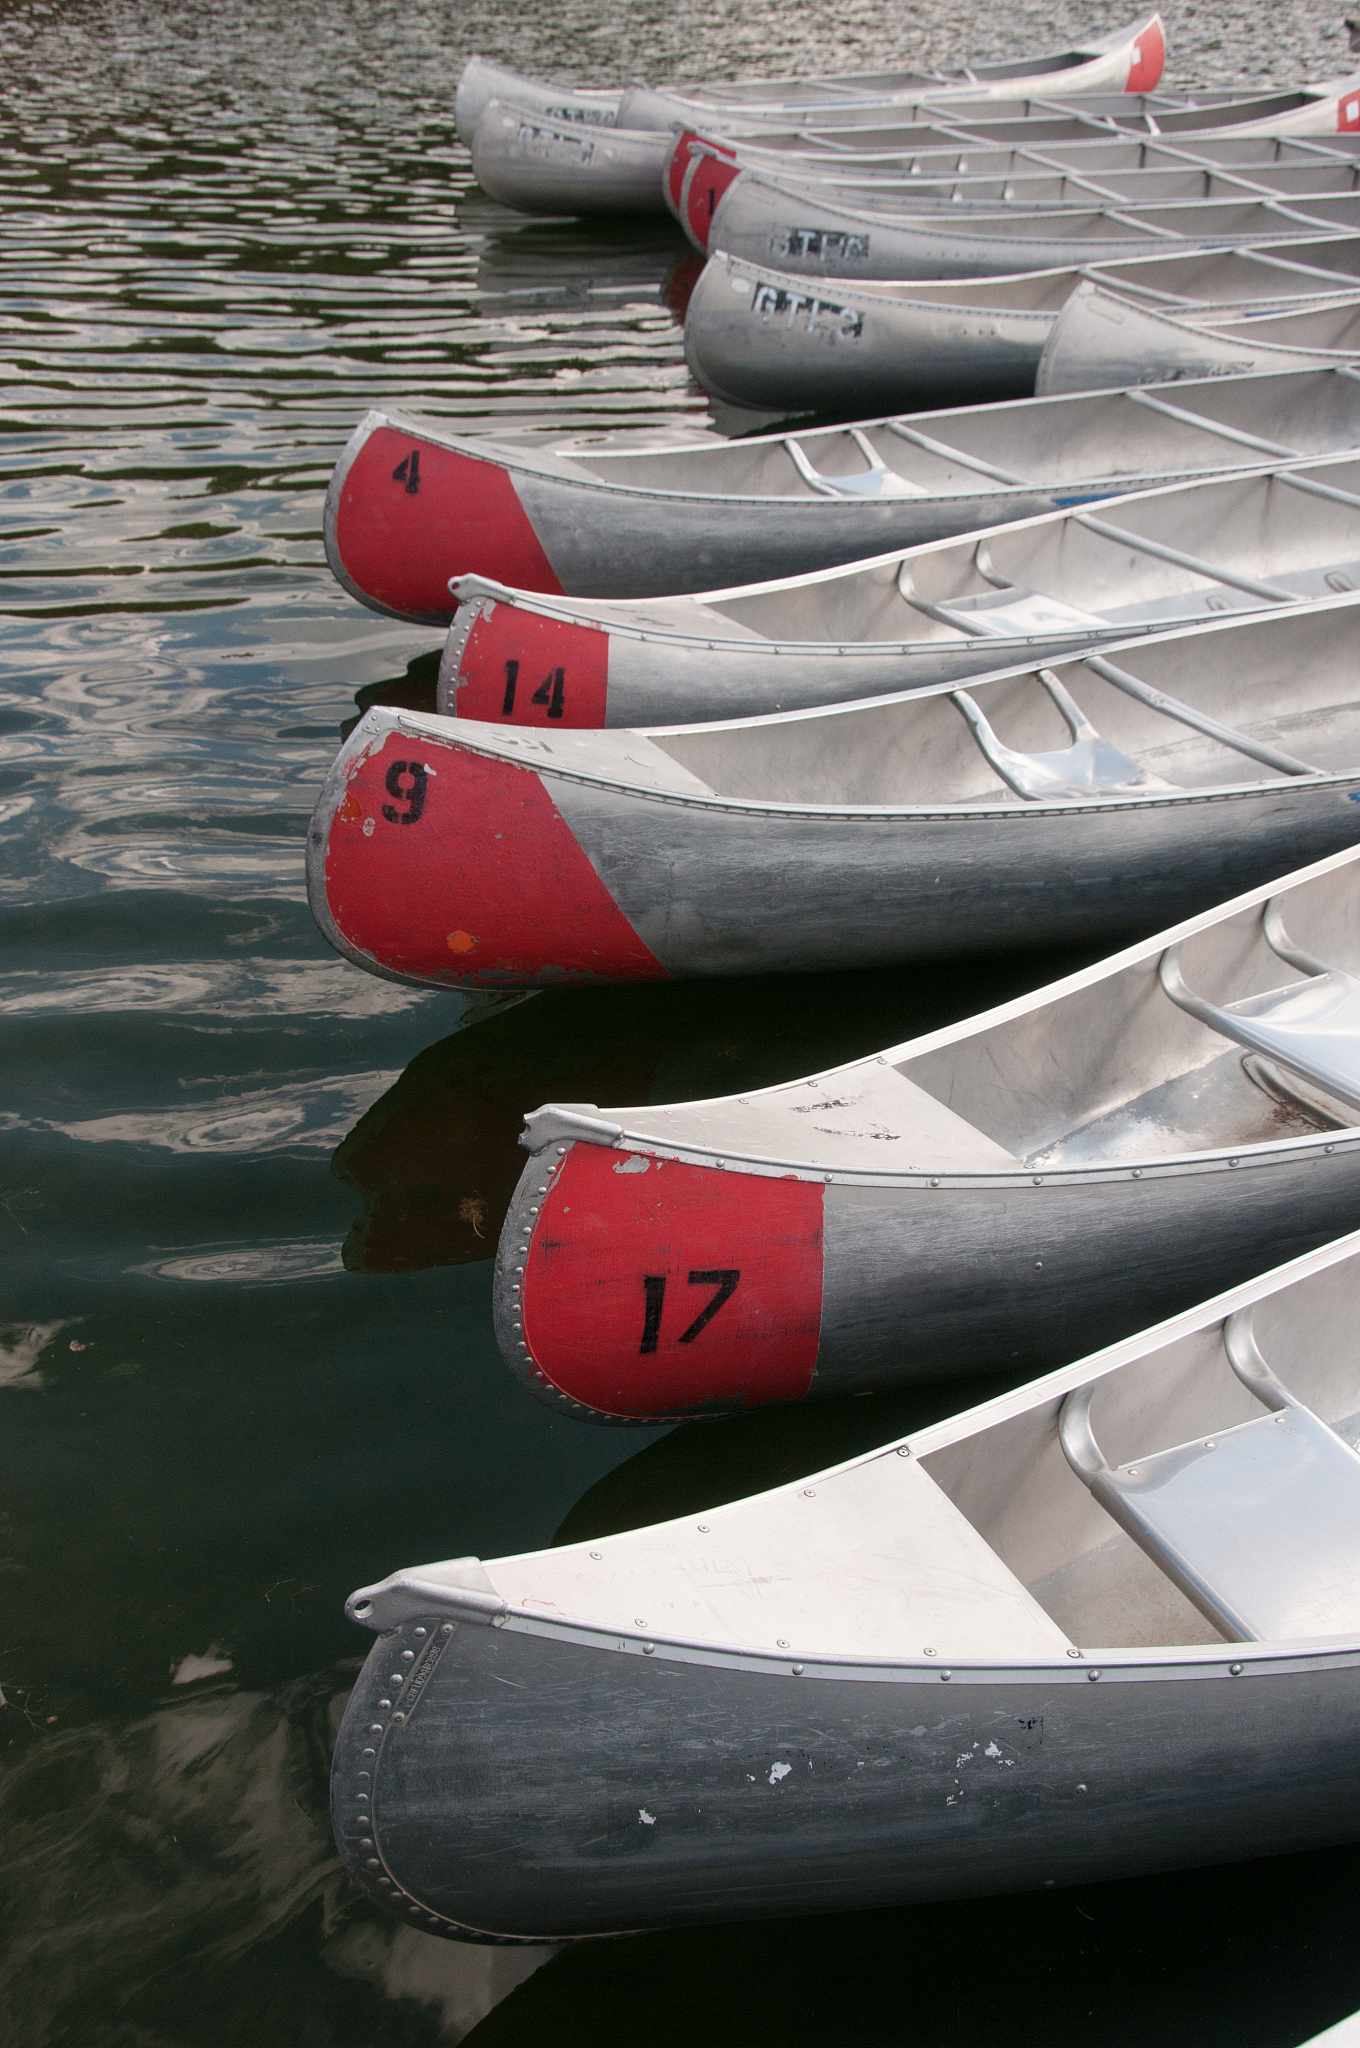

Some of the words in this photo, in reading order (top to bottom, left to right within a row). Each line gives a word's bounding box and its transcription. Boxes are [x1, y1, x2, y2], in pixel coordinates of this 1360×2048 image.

[392, 450, 420, 494] 4
[502, 659, 565, 718] 14
[382, 760, 428, 825] 9
[640, 1269, 740, 1354] 17
